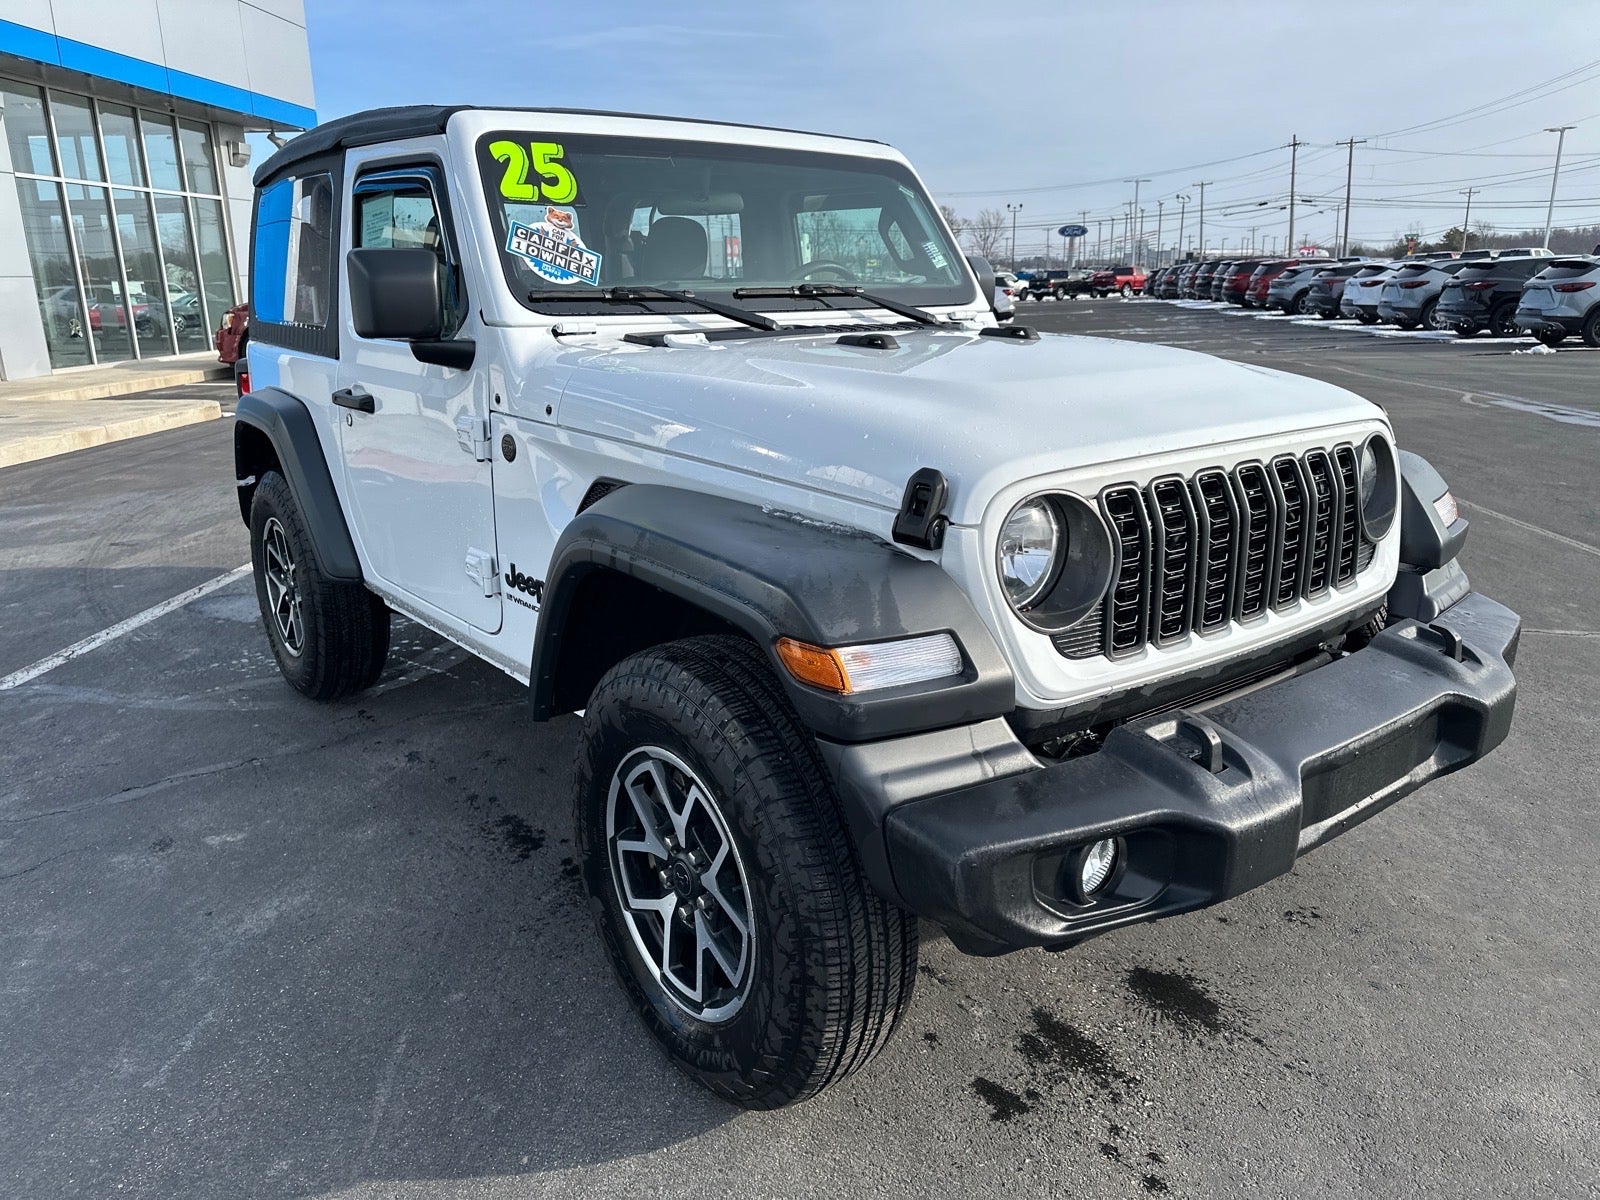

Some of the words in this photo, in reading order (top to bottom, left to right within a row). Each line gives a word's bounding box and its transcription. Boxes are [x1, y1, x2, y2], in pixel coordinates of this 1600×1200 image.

[489, 141, 578, 203] 25
[516, 228, 595, 267] CARFAX
[551, 228, 565, 237] CAR
[551, 233, 564, 242] FOX
[515, 240, 523, 251] 1
[527, 246, 592, 278] OWNER
[505, 562, 545, 604] Jeep
[512, 596, 541, 613] WRANG
